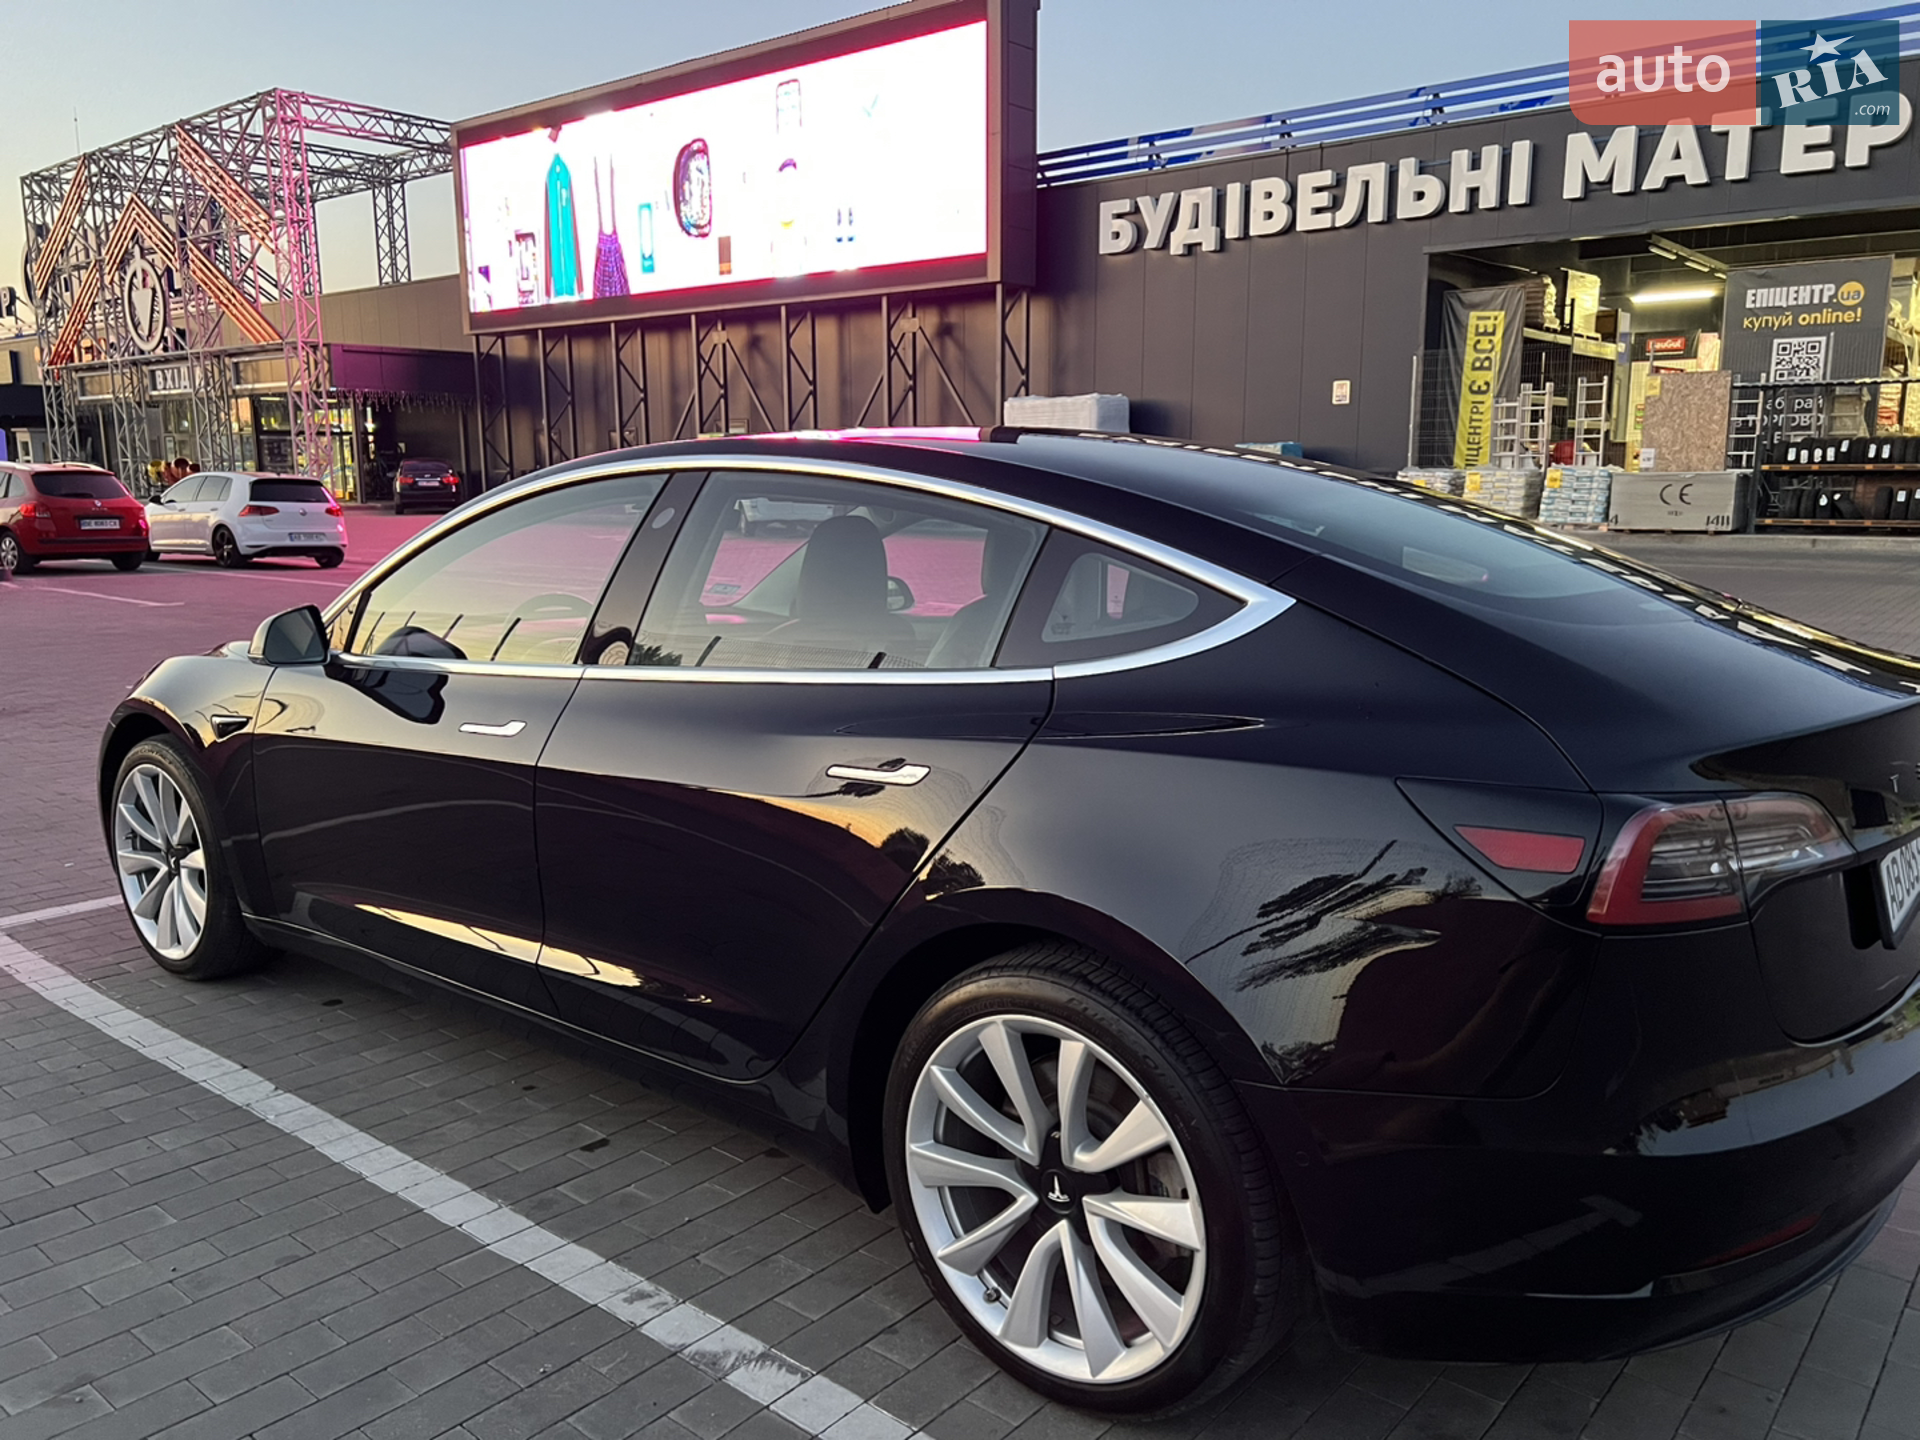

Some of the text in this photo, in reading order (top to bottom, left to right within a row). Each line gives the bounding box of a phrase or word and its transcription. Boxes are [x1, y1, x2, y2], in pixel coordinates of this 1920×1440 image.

[1098, 90, 1913, 256] БУДІВЕЛЬНІ МАТЕР
[1743, 307, 1862, 332] купуй online!
[1472, 315, 1498, 371] ВСЕ!
[1468, 380, 1491, 396] Є
